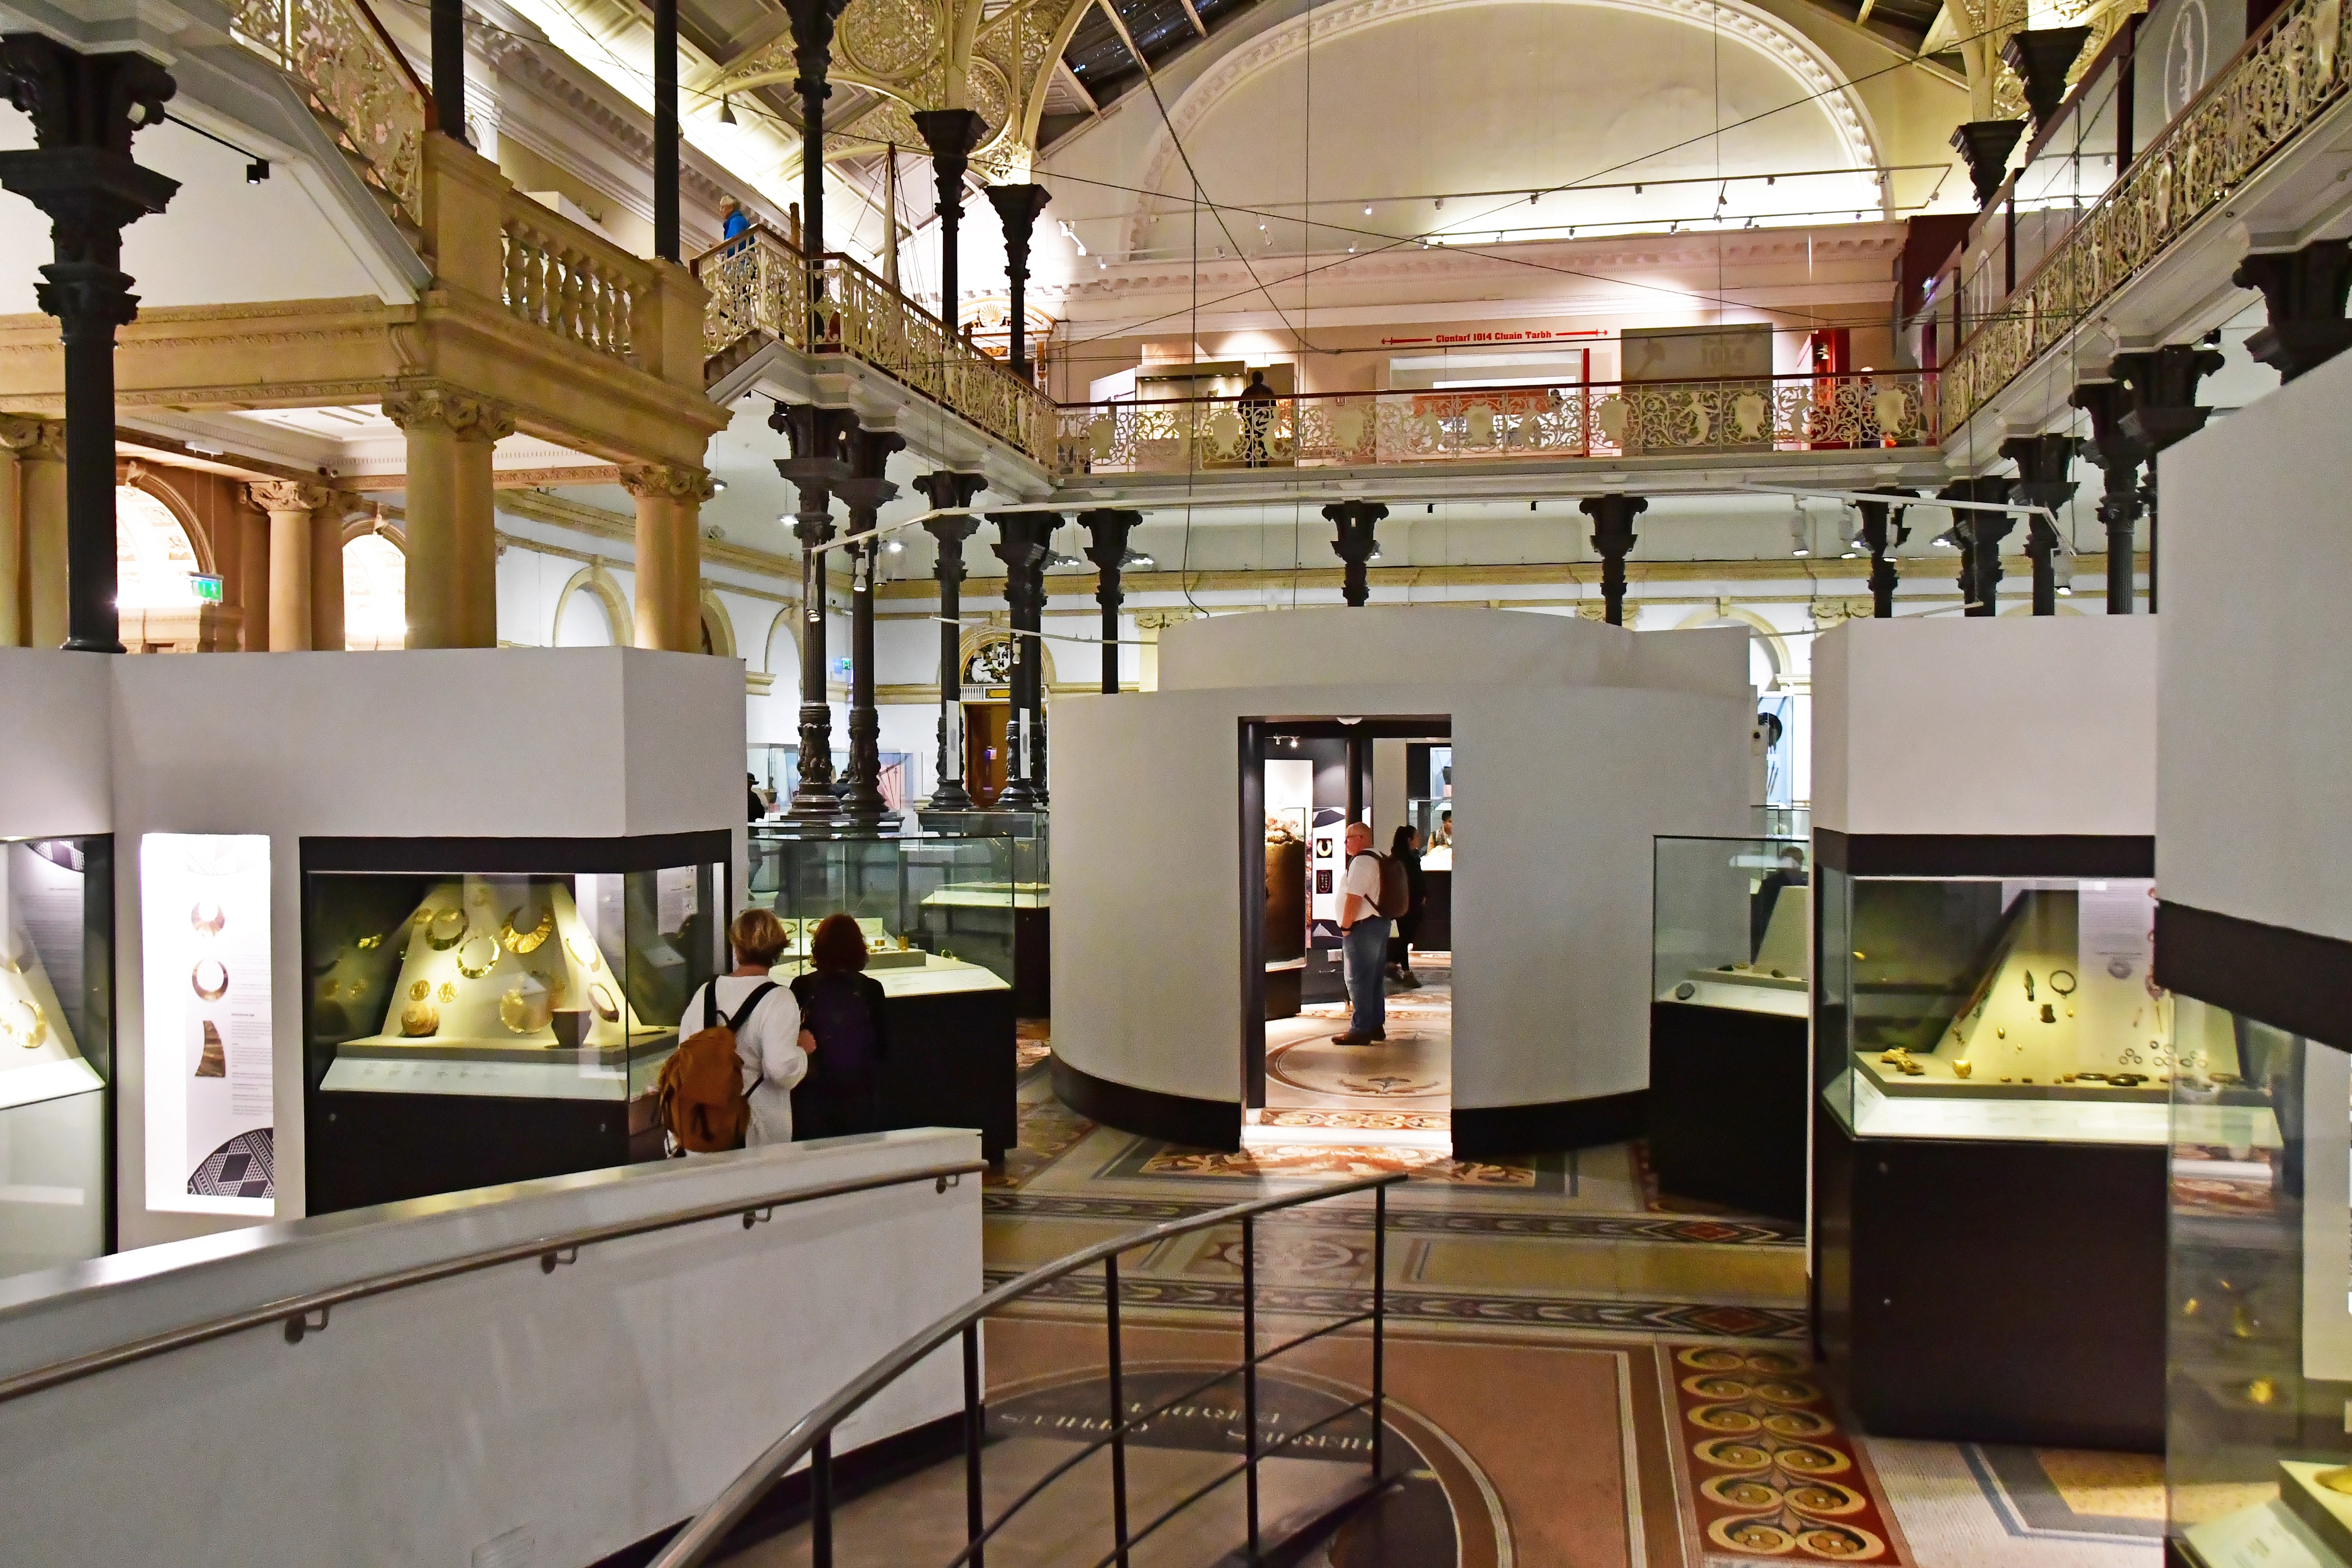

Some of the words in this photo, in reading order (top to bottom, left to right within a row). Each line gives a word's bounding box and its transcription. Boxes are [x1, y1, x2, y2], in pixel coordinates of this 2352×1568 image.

[1436, 334, 1470, 343] Clontarf
[1473, 333, 1492, 341] 1014
[1494, 332, 1522, 340] Cluain
[1525, 331, 1552, 339] Tarbh
